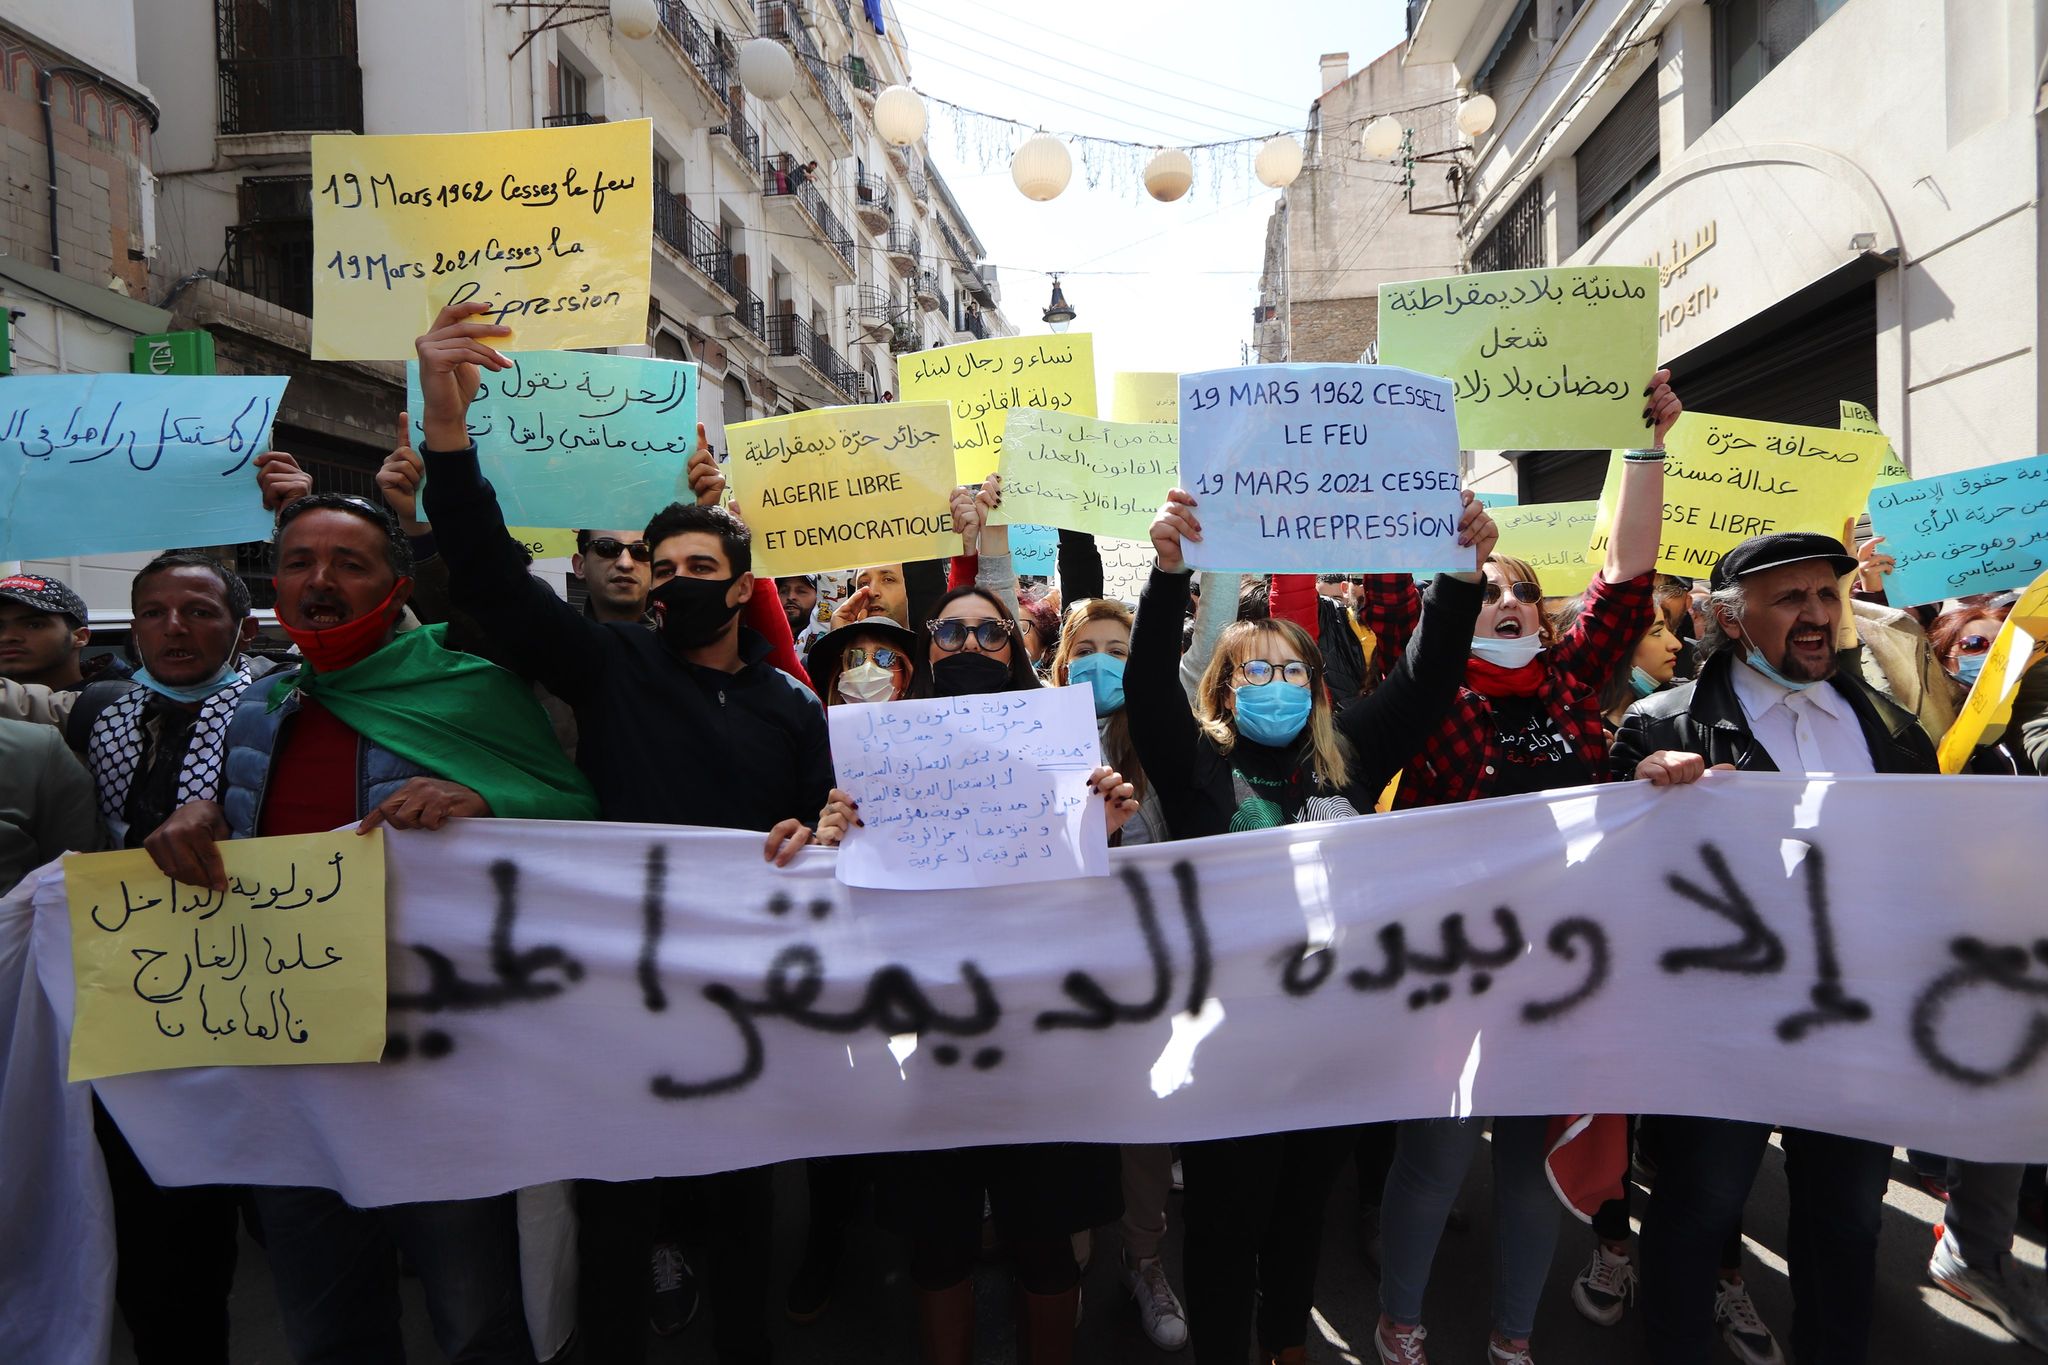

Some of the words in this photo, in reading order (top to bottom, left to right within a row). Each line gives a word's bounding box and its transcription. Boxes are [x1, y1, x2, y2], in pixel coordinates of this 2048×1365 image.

[322, 173, 362, 208] 19
[371, 173, 433, 208] Mars
[437, 180, 494, 208] 1962
[501, 174, 559, 207] Cessez
[593, 171, 635, 214] feu
[327, 251, 361, 280] 19
[367, 253, 427, 290] Mars
[432, 249, 480, 276] 2021
[486, 238, 543, 273] Cessez
[957, 353, 1004, 378] رجال
[1031, 346, 1073, 368] نساء
[1189, 386, 1221, 411] 19
[1229, 381, 1300, 406] MARS
[1310, 381, 1364, 405] 1962
[1373, 383, 1446, 412] CESSEZ
[1443, 370, 1492, 402] زلاب
[1537, 364, 1630, 401] رمضان
[957, 387, 1019, 419] القانون
[1284, 424, 1313, 445] LE
[1324, 424, 1368, 445] FEU
[1766, 435, 1859, 464] صحافة
[762, 480, 840, 508] ALGERIE
[846, 473, 903, 498] LIBRE
[1196, 473, 1224, 495] 19
[1234, 470, 1309, 496] MARS
[1317, 473, 1374, 494] 2021
[1381, 470, 1461, 492] CESSEZ
[1727, 467, 1798, 495] عدالة
[1102, 495, 1158, 516] ساواة
[1662, 503, 1702, 526] SSE
[765, 530, 787, 550] ET
[795, 513, 953, 547] DEMOCRATIQUE
[1683, 546, 1722, 568] IND
